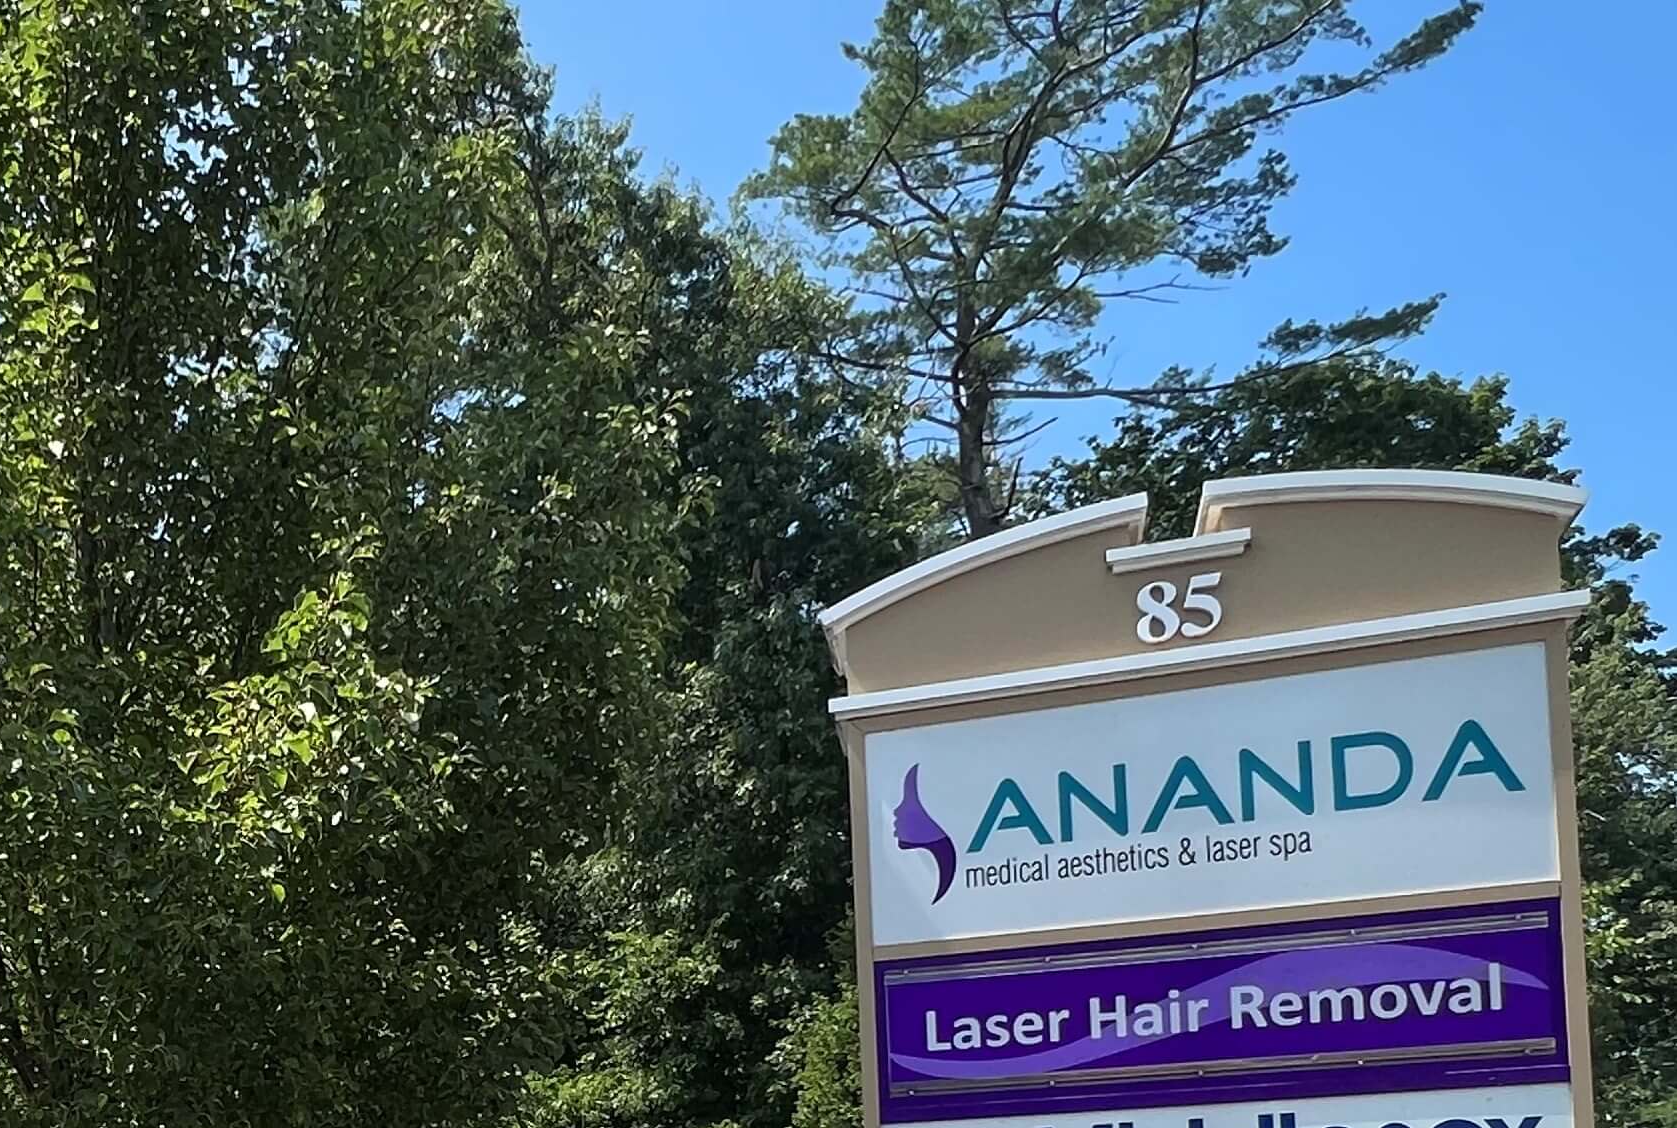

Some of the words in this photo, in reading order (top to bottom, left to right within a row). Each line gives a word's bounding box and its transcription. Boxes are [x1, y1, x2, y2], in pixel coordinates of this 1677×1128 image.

[1136, 571, 1222, 644] 85
[966, 719, 1526, 853] ANANDA
[965, 854, 1050, 888] medical
[1057, 843, 1170, 880] aesthetics
[1178, 837, 1197, 866] &
[1206, 835, 1262, 864] laser
[1269, 831, 1313, 861] spa
[925, 1008, 1070, 1052] Laser
[1089, 989, 1210, 1039] Hair
[1229, 962, 1504, 1030] Removal
